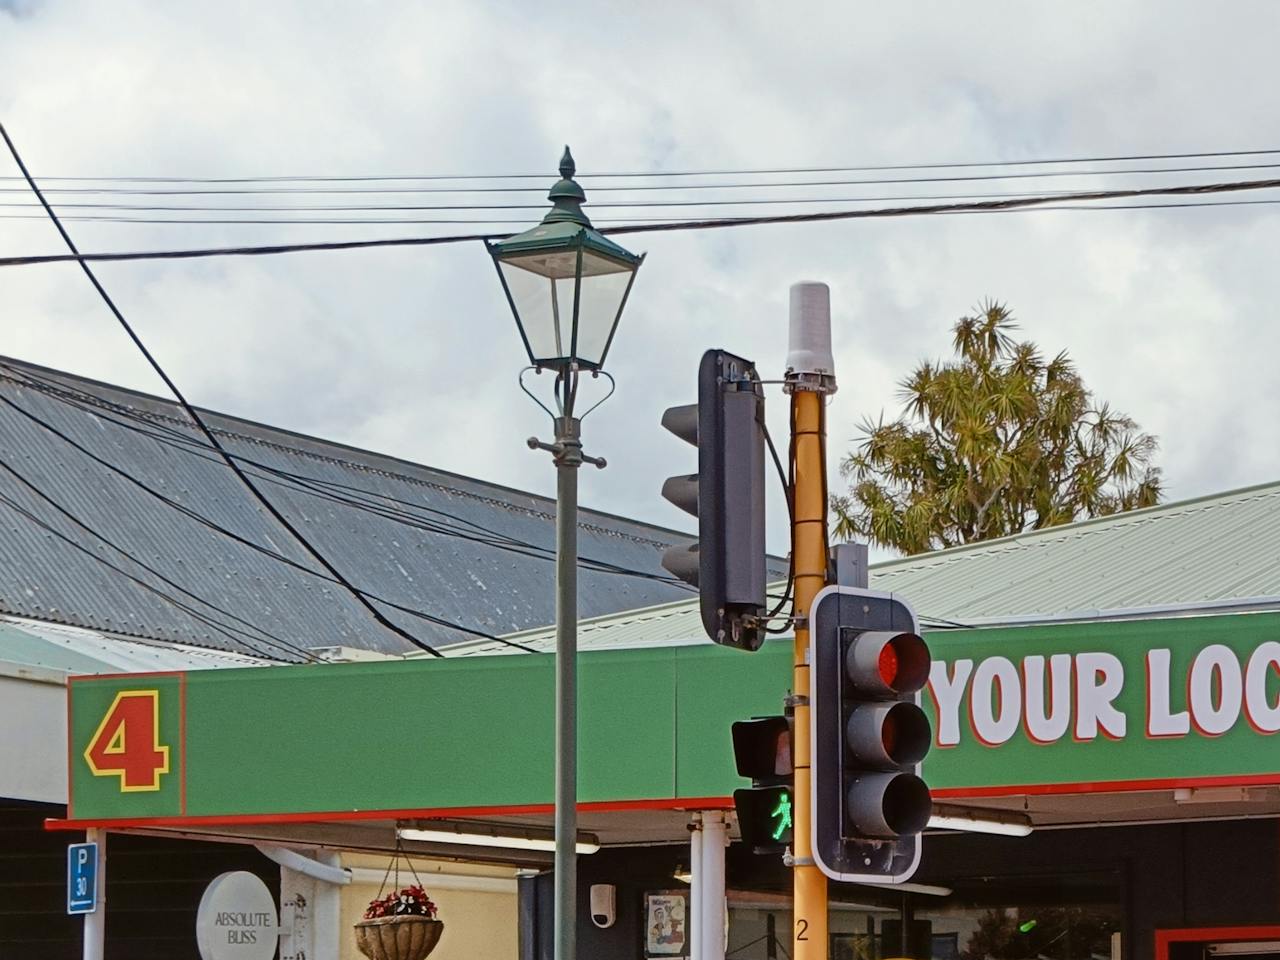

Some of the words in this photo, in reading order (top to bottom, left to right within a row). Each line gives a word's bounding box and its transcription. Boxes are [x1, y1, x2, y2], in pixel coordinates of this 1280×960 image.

[928, 652, 1126, 747] YOUR
[84, 690, 169, 792] 4
[78, 848, 88, 873] P
[215, 912, 271, 927] ABSOLUTE
[796, 919, 809, 941] 2
[228, 930, 257, 944] BLISS
